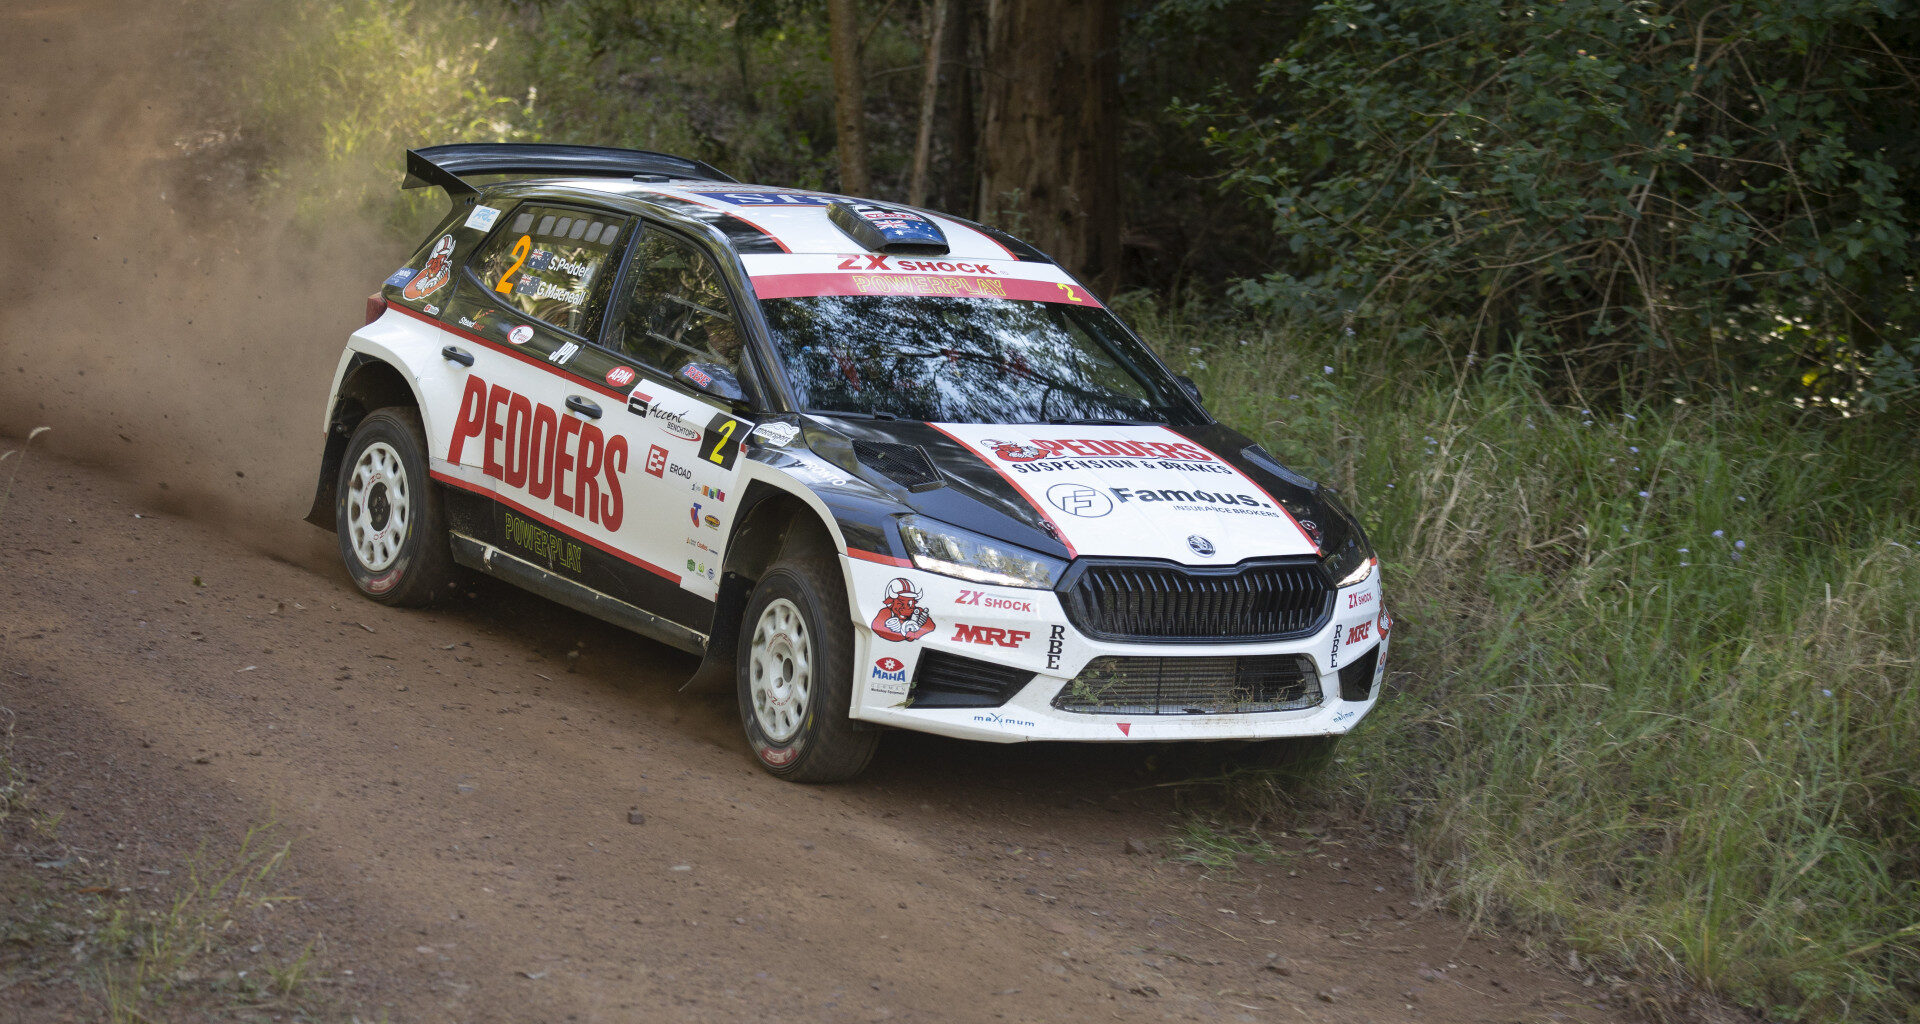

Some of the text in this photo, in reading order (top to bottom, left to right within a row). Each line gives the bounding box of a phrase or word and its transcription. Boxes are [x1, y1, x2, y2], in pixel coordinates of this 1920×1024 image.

[495, 234, 531, 294] 2
[837, 254, 999, 275] ZX SHOCK
[852, 274, 1007, 297] POWERPLAY
[1056, 282, 1082, 302] 2
[608, 368, 634, 385] APM
[649, 402, 689, 423] Accent
[667, 421, 696, 439] BENCHTOPS
[447, 373, 629, 533] PEDDERS
[709, 420, 737, 465] 2
[1030, 438, 1213, 462] PEDDERS
[669, 463, 692, 480] EROAD
[1011, 459, 1233, 475] SUSPENSION & BRAKES
[1173, 505, 1280, 518] INSURANCE BROKERS
[955, 590, 1032, 613] ZX SHOCK
[1348, 592, 1358, 609] ZX
[951, 623, 1031, 649] MRF
[1345, 620, 1372, 645] MRF
[872, 665, 906, 682] MAHA
